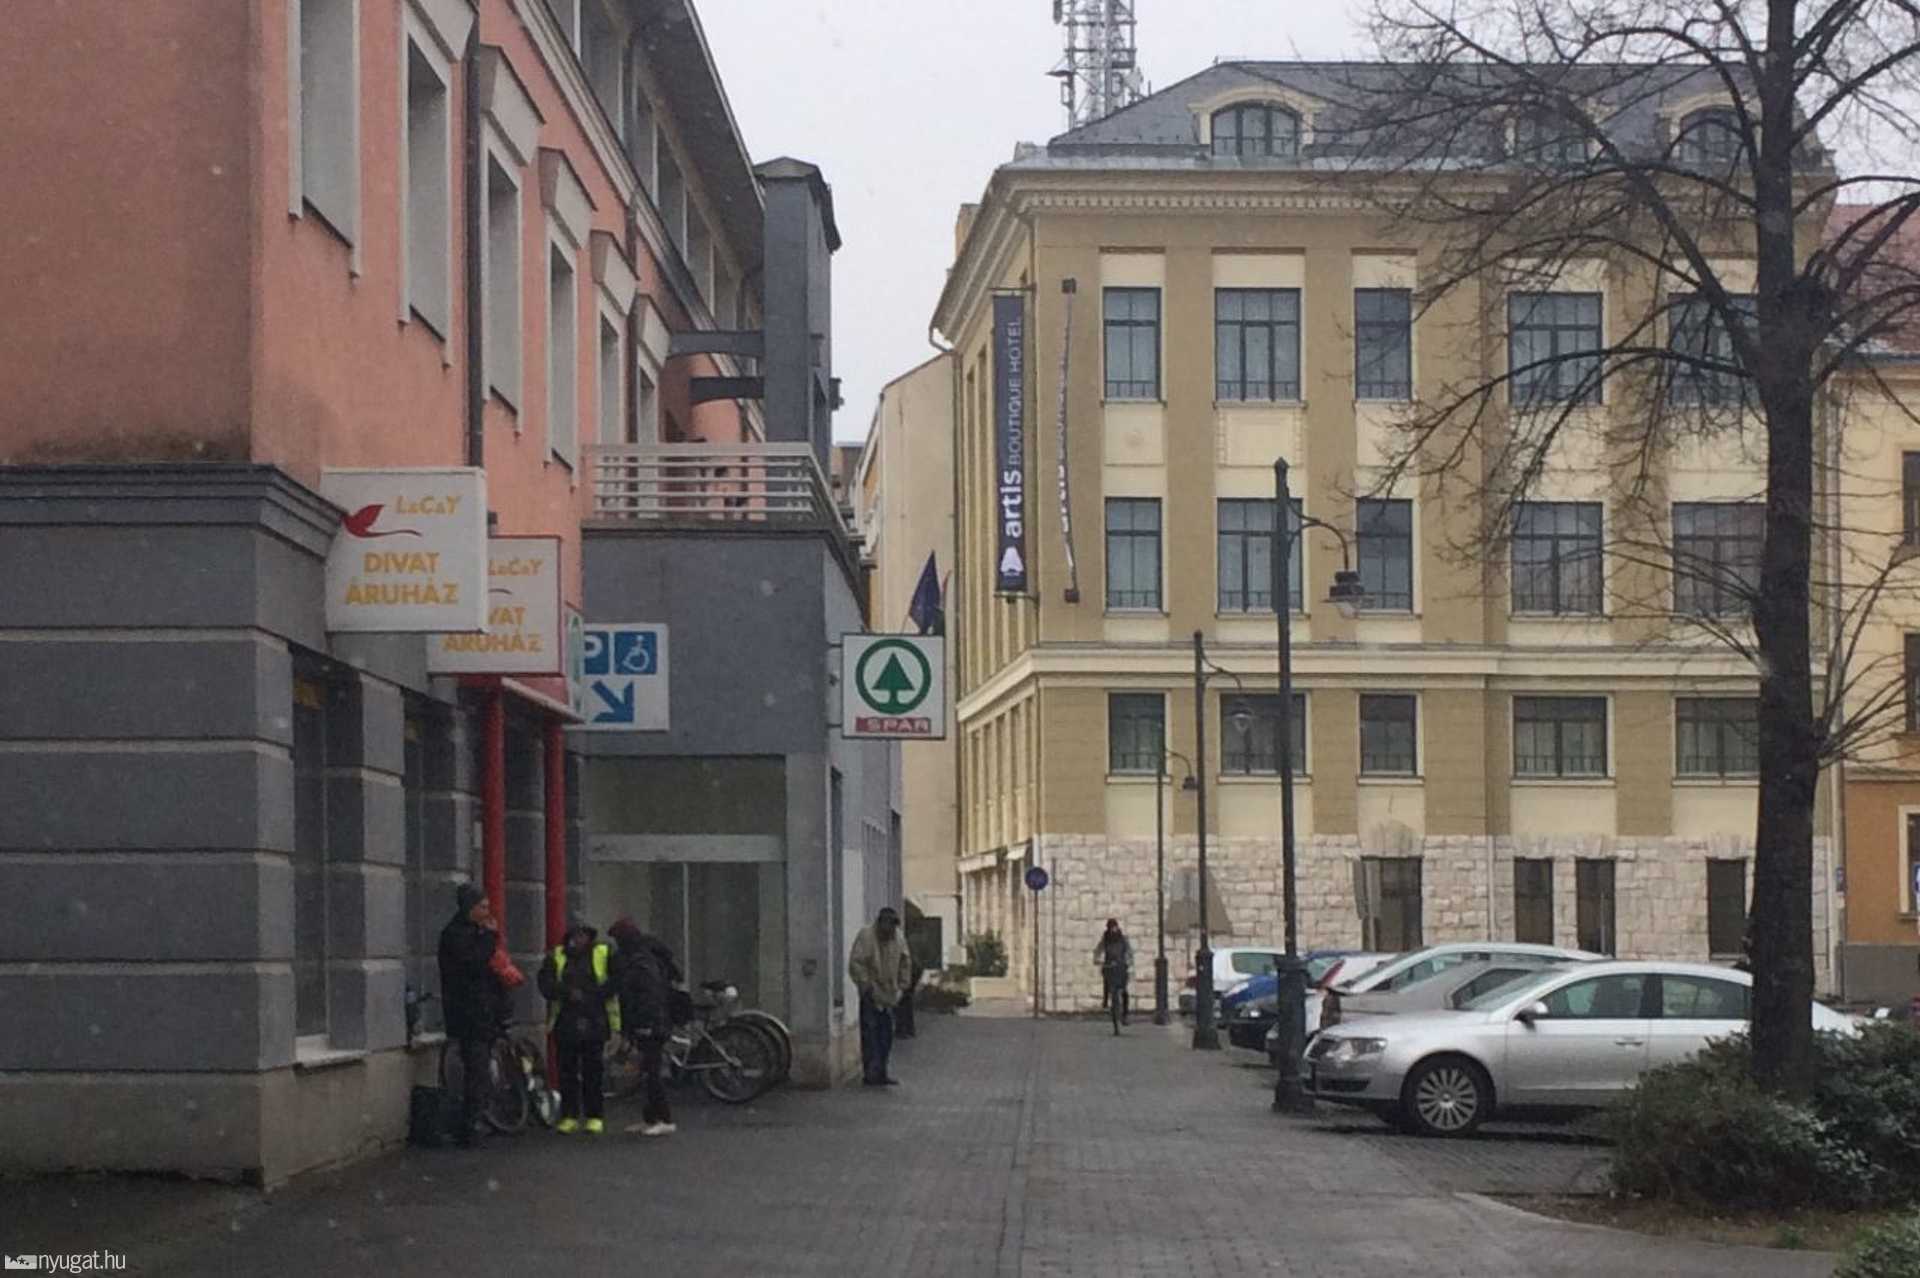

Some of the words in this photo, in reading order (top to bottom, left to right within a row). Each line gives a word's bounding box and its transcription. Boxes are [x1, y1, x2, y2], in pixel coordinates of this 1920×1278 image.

[1008, 316, 1022, 373] HOTEL
[1008, 378, 1022, 466] BOUTIQUE
[364, 552, 440, 574] DIVAT
[866, 718, 929, 732] SPAR
